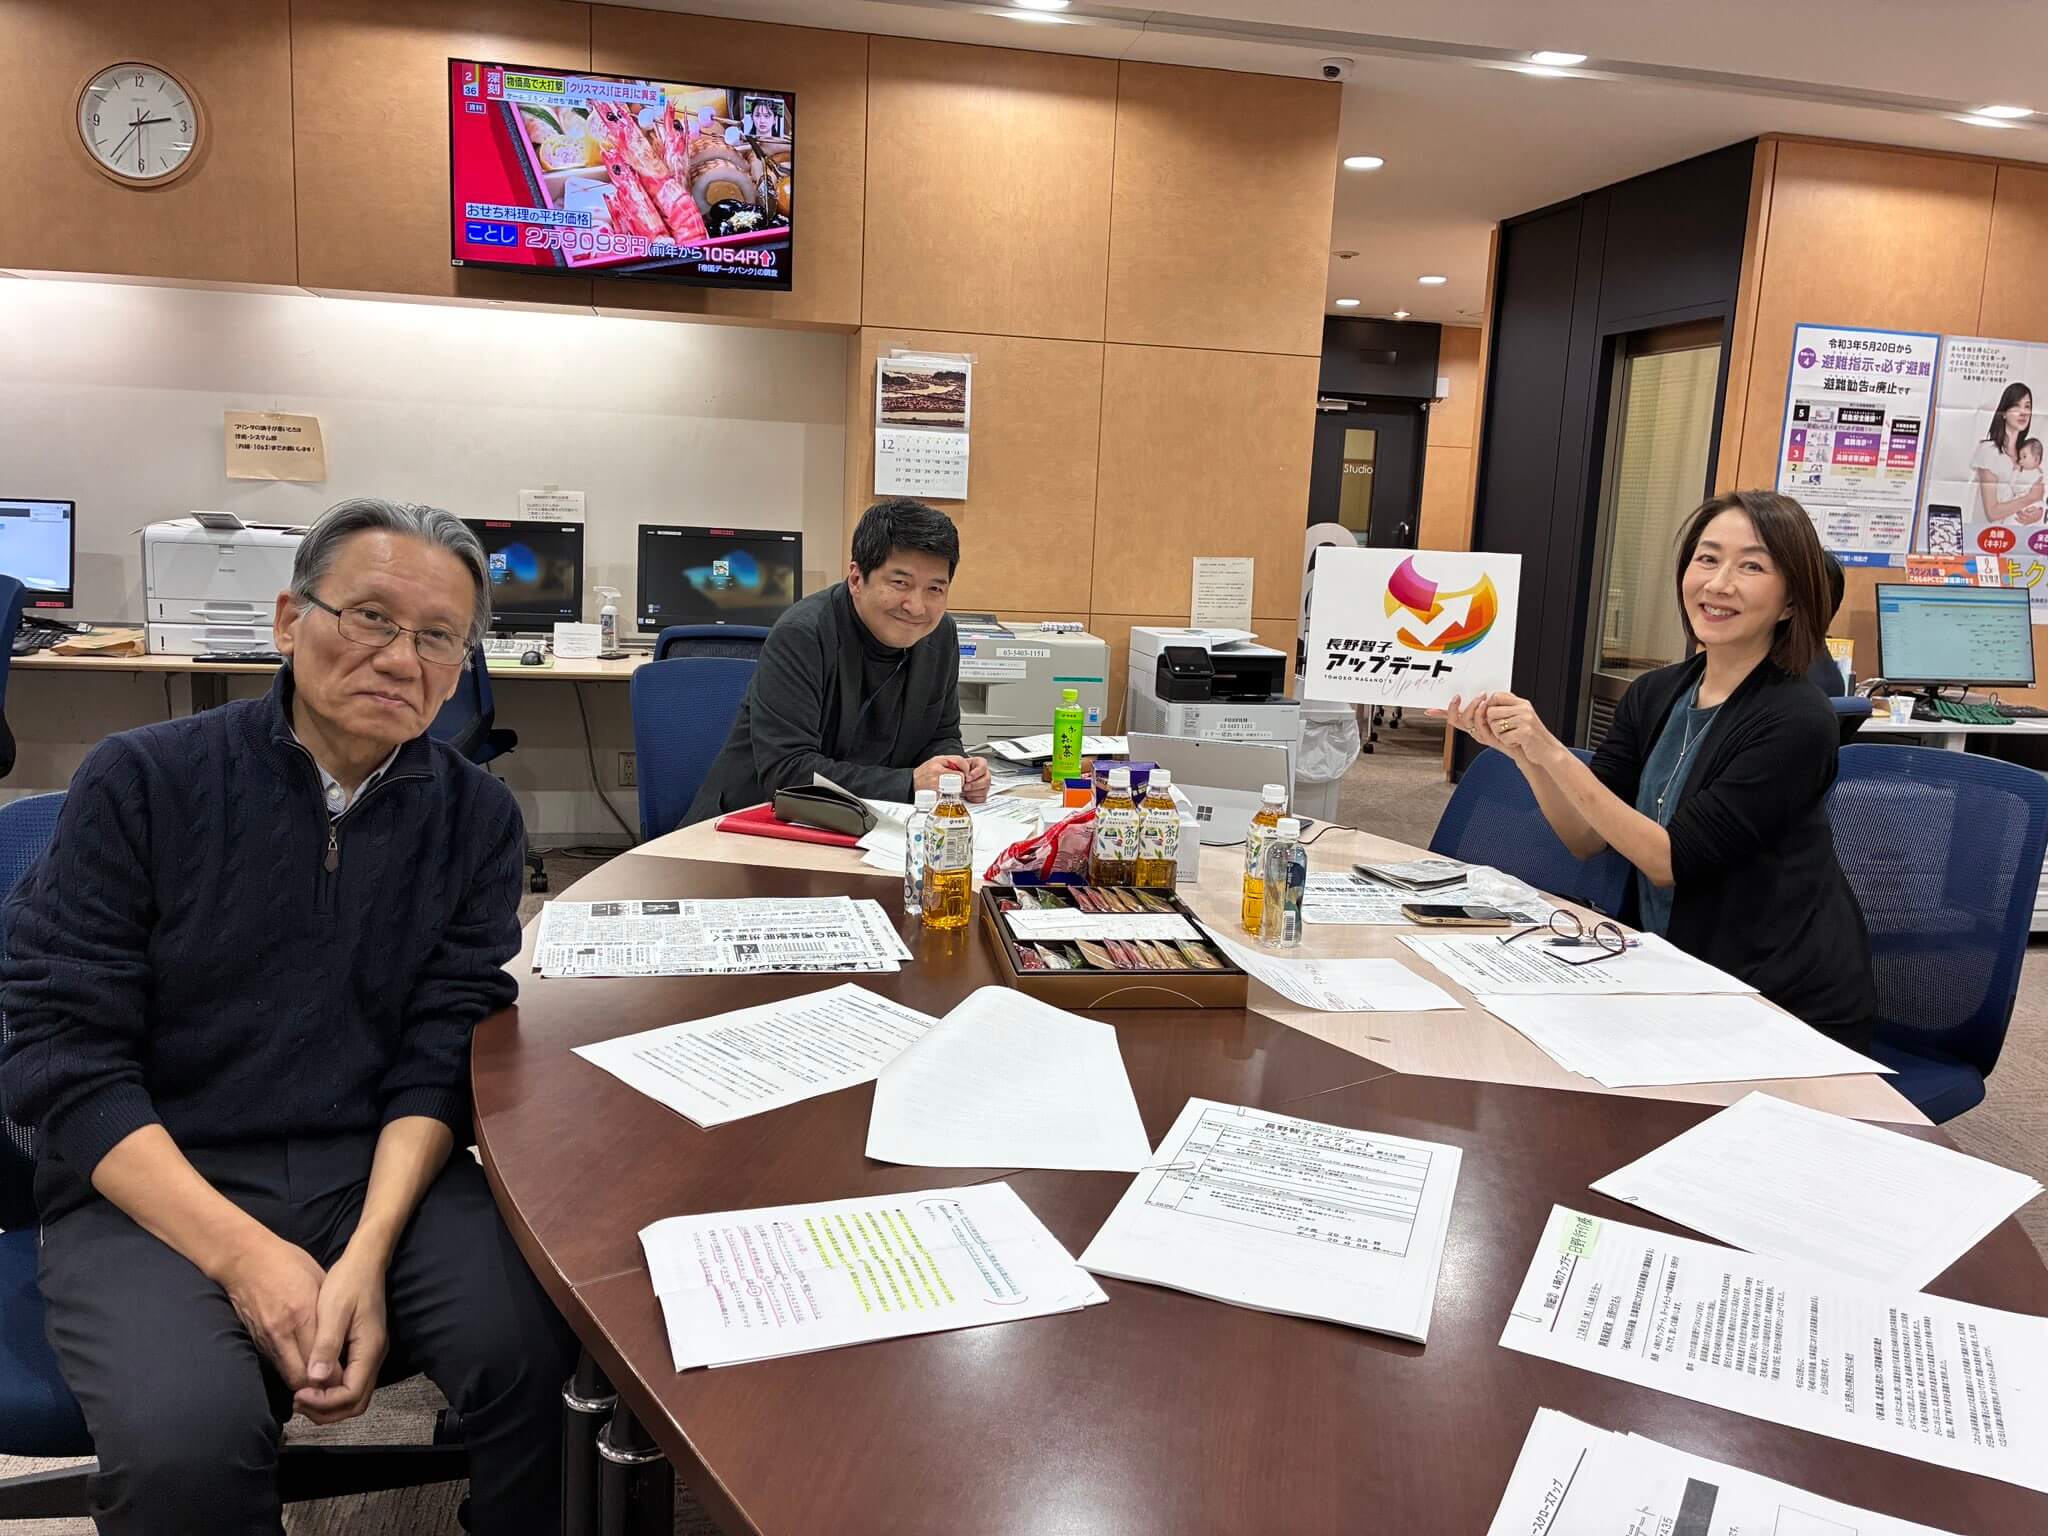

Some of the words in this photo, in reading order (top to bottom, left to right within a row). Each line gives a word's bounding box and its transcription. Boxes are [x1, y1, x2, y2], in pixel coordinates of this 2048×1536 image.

[135, 74, 144, 88] 12
[465, 72, 472, 81] 2
[487, 72, 500, 95] 深刻
[506, 74, 564, 93] 物価高で大打撃
[465, 86, 477, 95] 36
[93, 113, 100, 126] 9
[180, 120, 187, 133] 3
[138, 158, 145, 172] 6
[466, 204, 590, 226] おせち料理の平均価格
[467, 225, 515, 244] ことし
[526, 227, 648, 257] 2万9098円
[1828, 338, 1912, 354] 令和3年5月20日から
[1821, 354, 1931, 377] 避難指示で必ず避難
[1823, 377, 1911, 395] 避難勧告は廃止です
[881, 439, 895, 450] 12
[1795, 433, 1801, 442] 4
[1793, 449, 1799, 458] 3
[1343, 464, 1374, 475] Studio
[1326, 638, 1393, 653] 長野智子
[1326, 653, 1453, 678] アップデート
[1124, 825, 1135, 857] 茶の間
[1165, 825, 1175, 856] 茶の間
[1568, 1216, 1593, 1254] 日野行介様
[1531, 1478, 1563, 1536] ースクローズアップ
